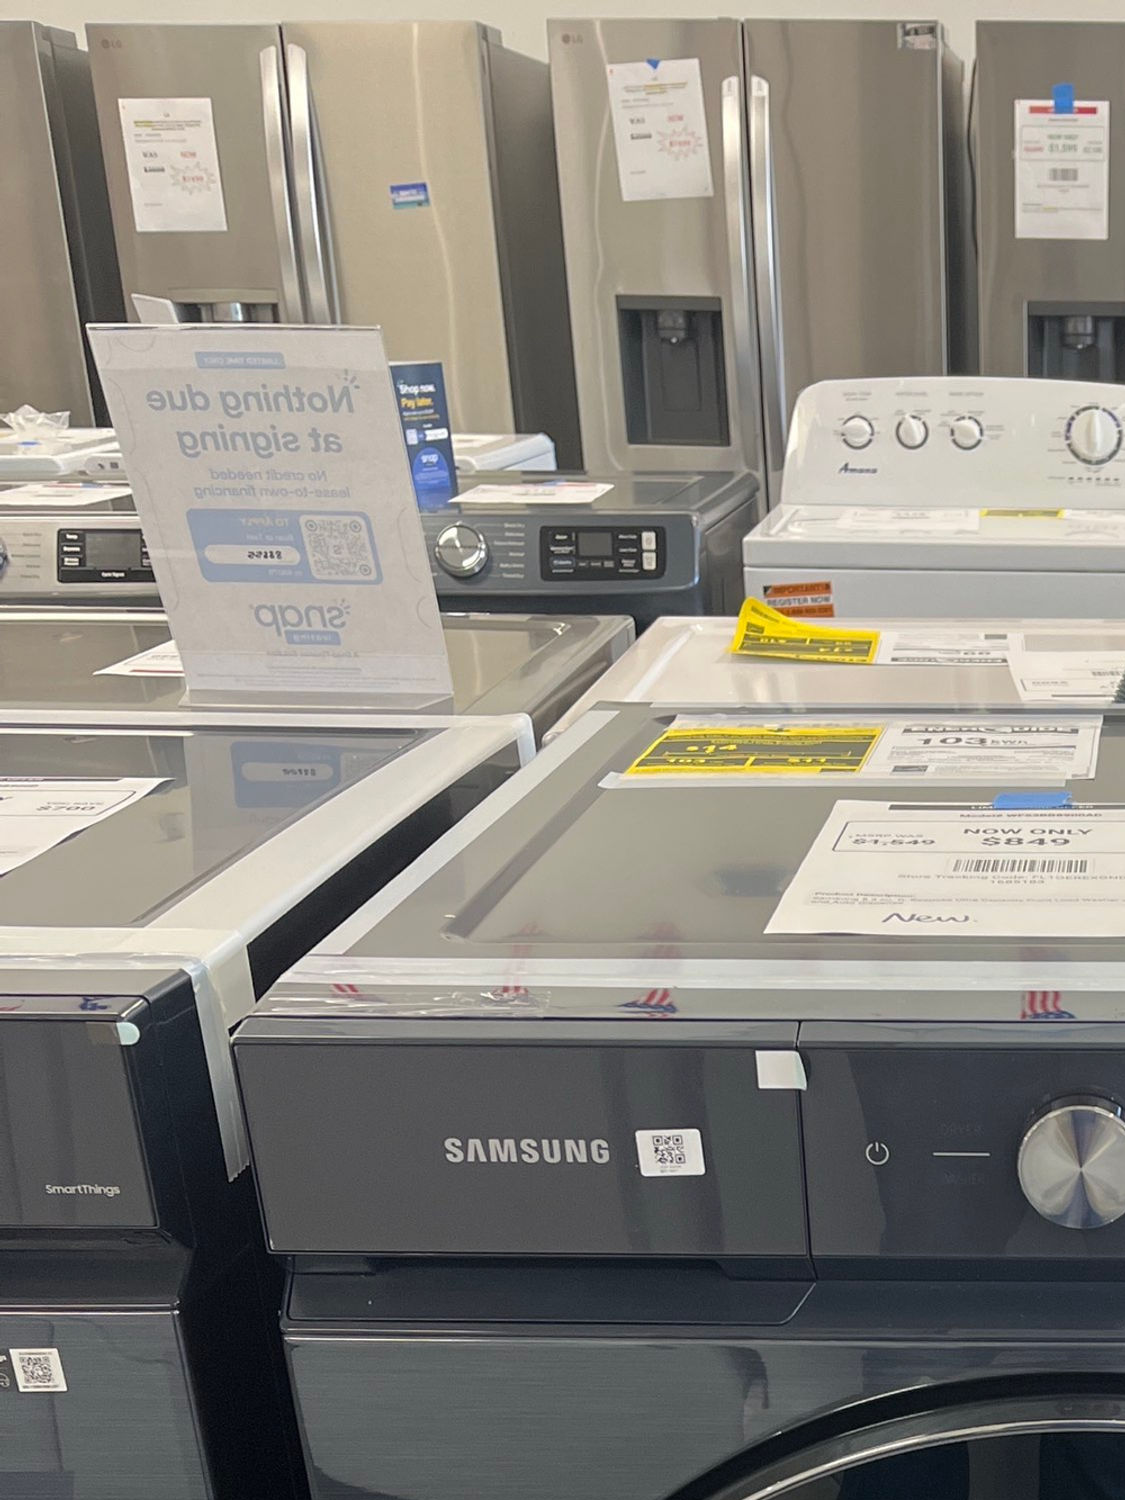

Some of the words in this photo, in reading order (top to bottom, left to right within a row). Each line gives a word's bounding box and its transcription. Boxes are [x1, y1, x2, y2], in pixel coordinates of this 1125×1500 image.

[839, 463, 877, 474] Amana
[767, 597, 808, 606] REGISTER
[810, 596, 831, 604] NOW
[918, 737, 986, 746] 103
[981, 836, 1071, 847] $849
[443, 1136, 611, 1165] SAMSUNG
[44, 1183, 121, 1198] SmartThings
